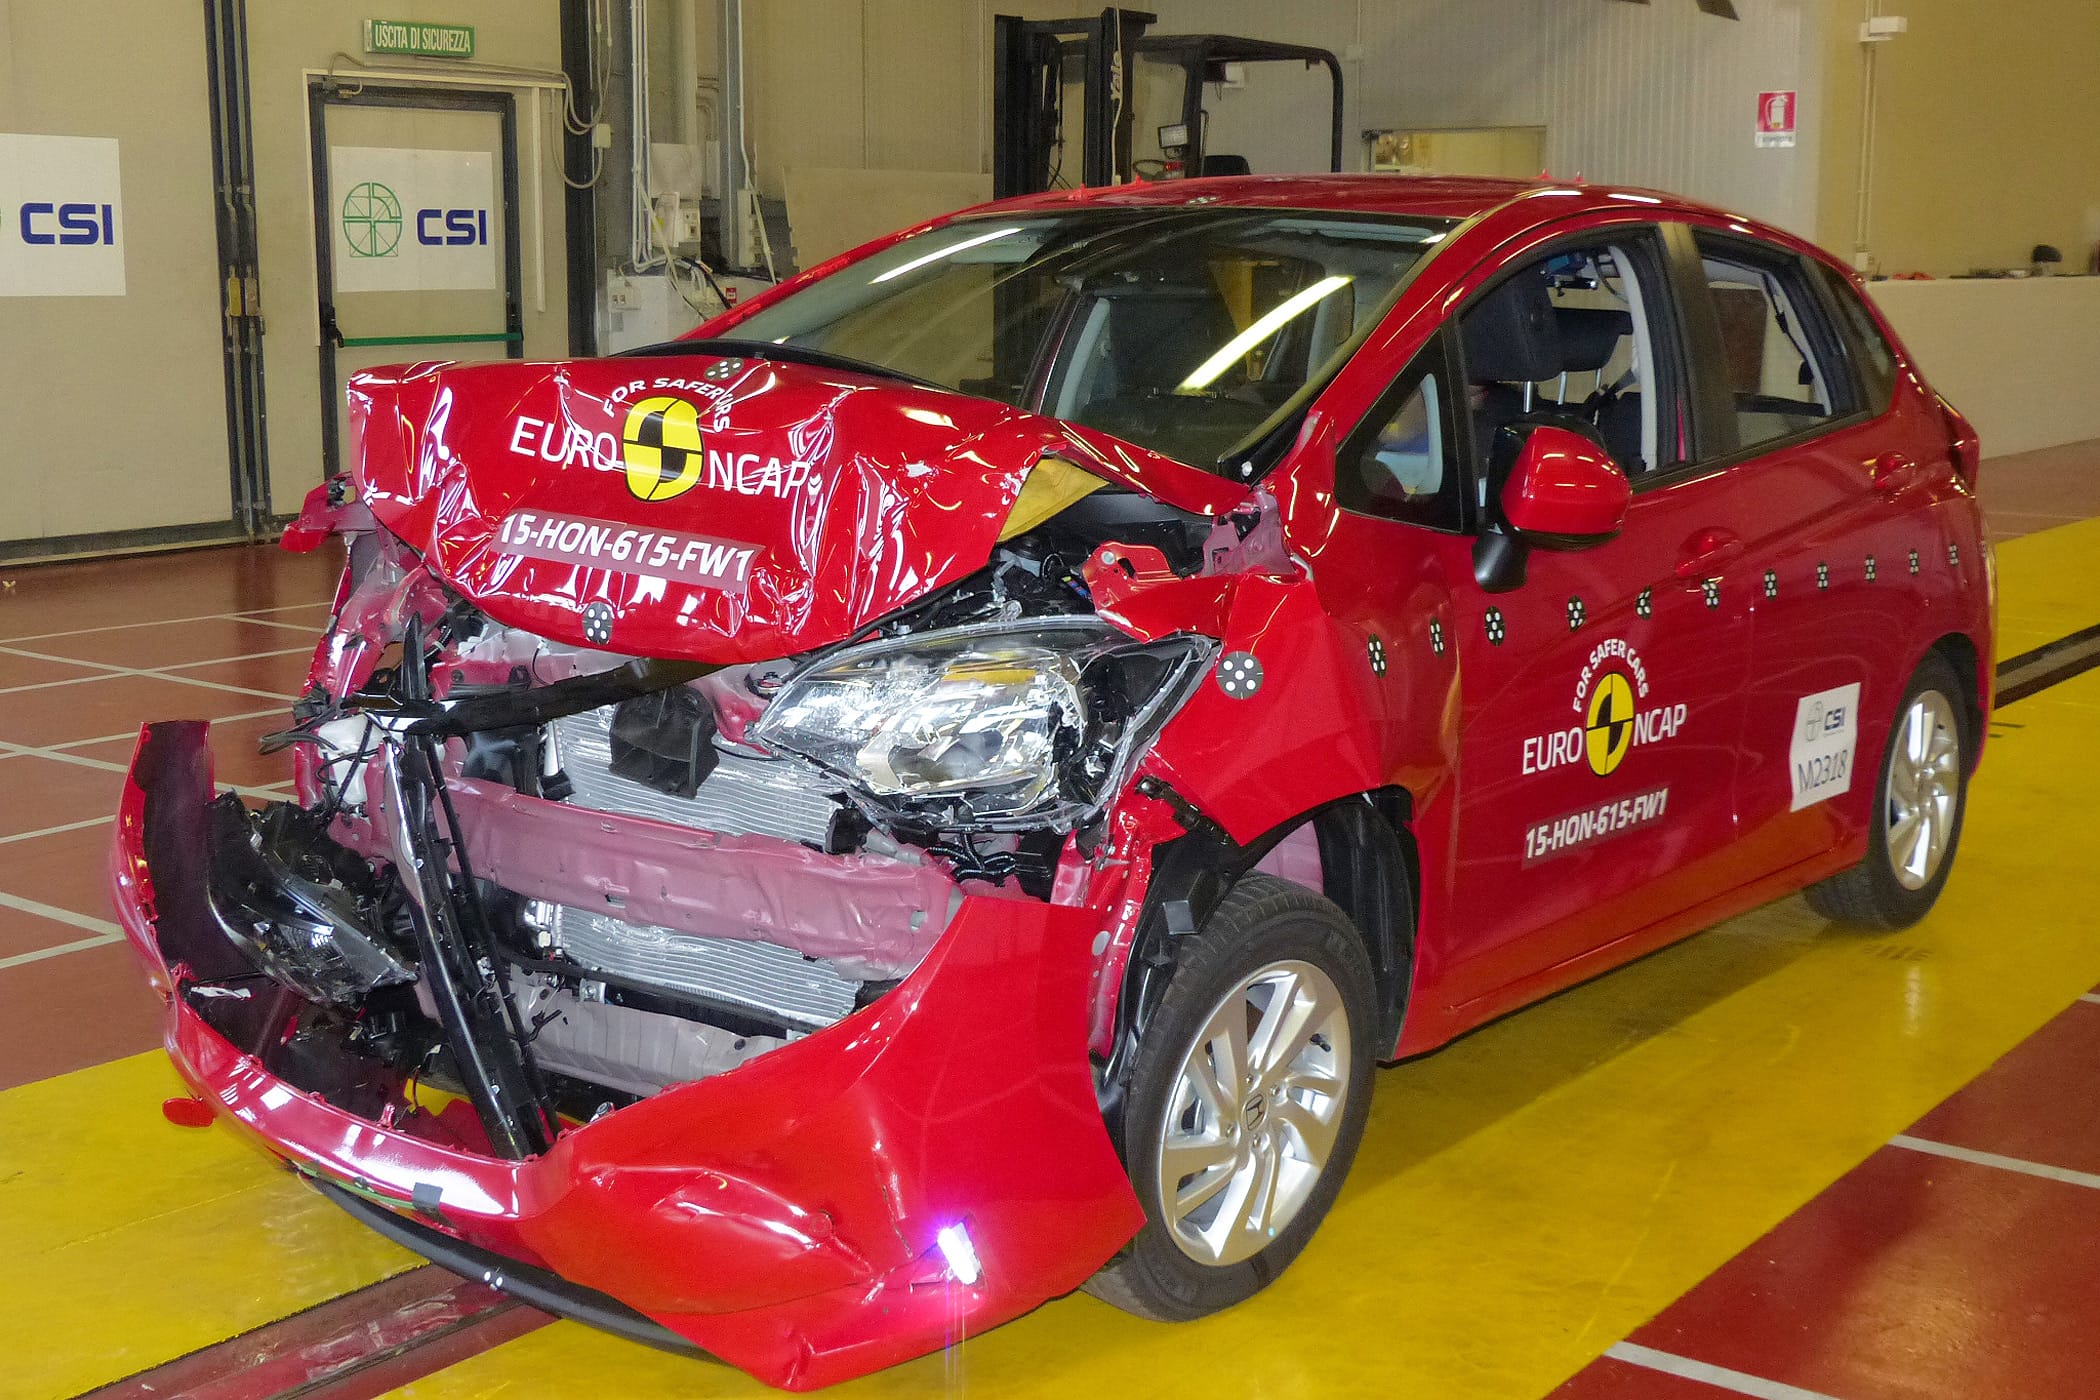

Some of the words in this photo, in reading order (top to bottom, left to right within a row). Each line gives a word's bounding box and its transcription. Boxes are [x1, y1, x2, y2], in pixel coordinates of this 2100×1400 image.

[375, 24, 408, 49] USCITA
[410, 26, 420, 49] DI
[422, 27, 471, 53] SICUREZZA
[20, 202, 114, 246] CSI
[416, 208, 488, 246] CSI
[602, 379, 647, 419] FOR
[509, 415, 618, 472] EURO
[707, 450, 811, 500] NCAP
[501, 513, 755, 582] 15-HON-615-FW1
[1572, 665, 1593, 713] FOR
[1589, 638, 1627, 671] SAFER
[1626, 647, 1649, 699] CARS
[1522, 726, 1584, 776] EURO
[1632, 703, 1688, 747] NCAP
[1823, 706, 1846, 731] CSI
[1797, 749, 1848, 794] M2318
[1526, 787, 1668, 859] 15-HON-615-FW1
